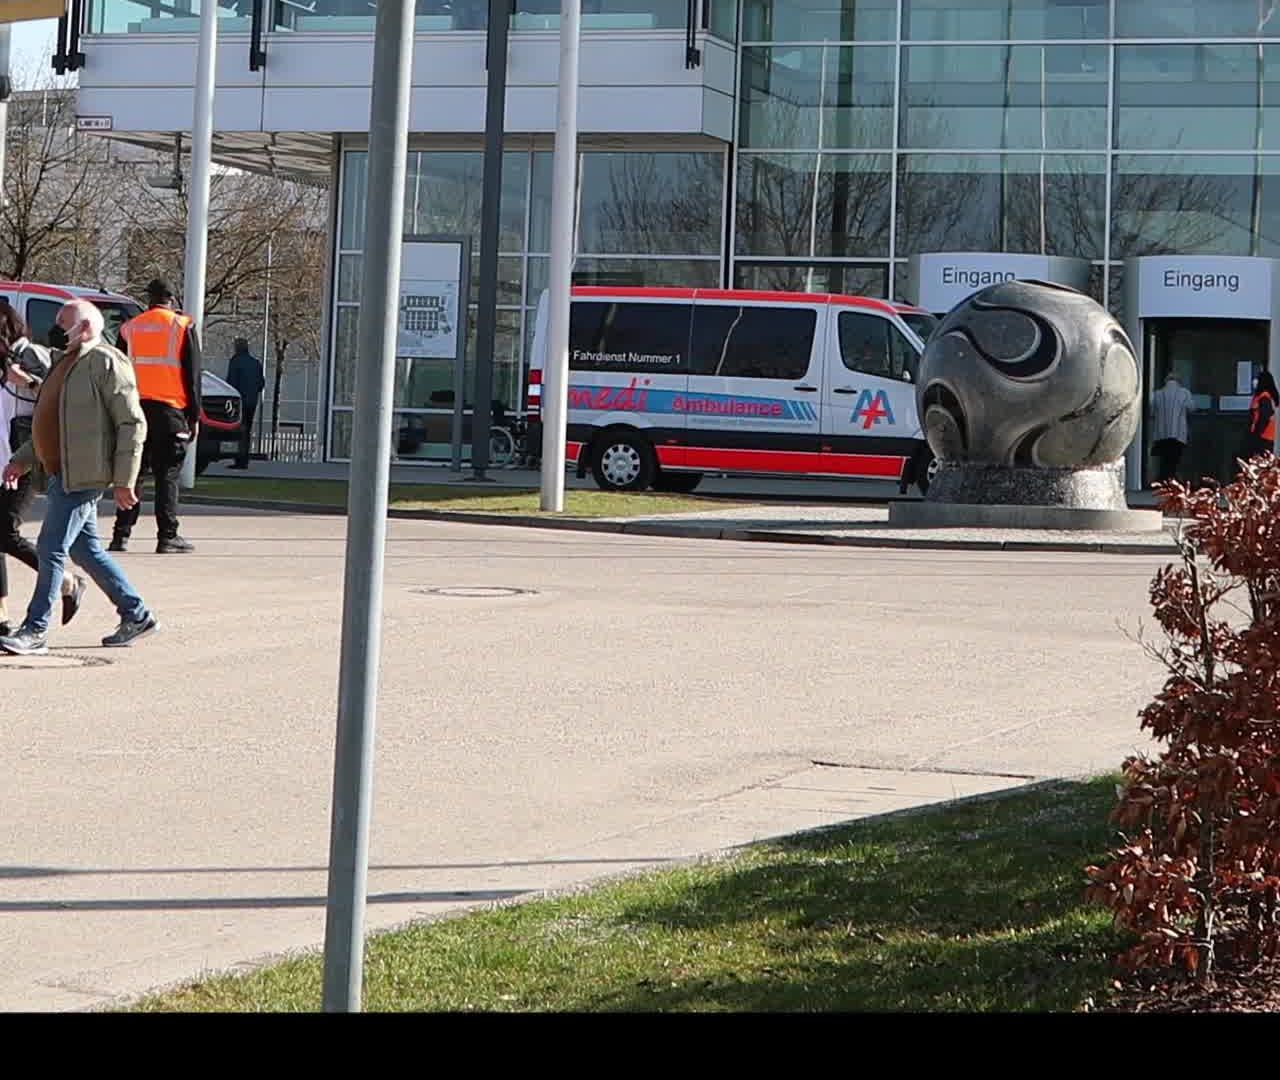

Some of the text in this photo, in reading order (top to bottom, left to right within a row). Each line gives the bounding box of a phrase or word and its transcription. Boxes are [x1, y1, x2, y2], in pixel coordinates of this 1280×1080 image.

[942, 267, 1016, 286] Eingang
[1163, 270, 1240, 292] Eingang
[573, 350, 681, 364] Fahrdienst Nummer 1
